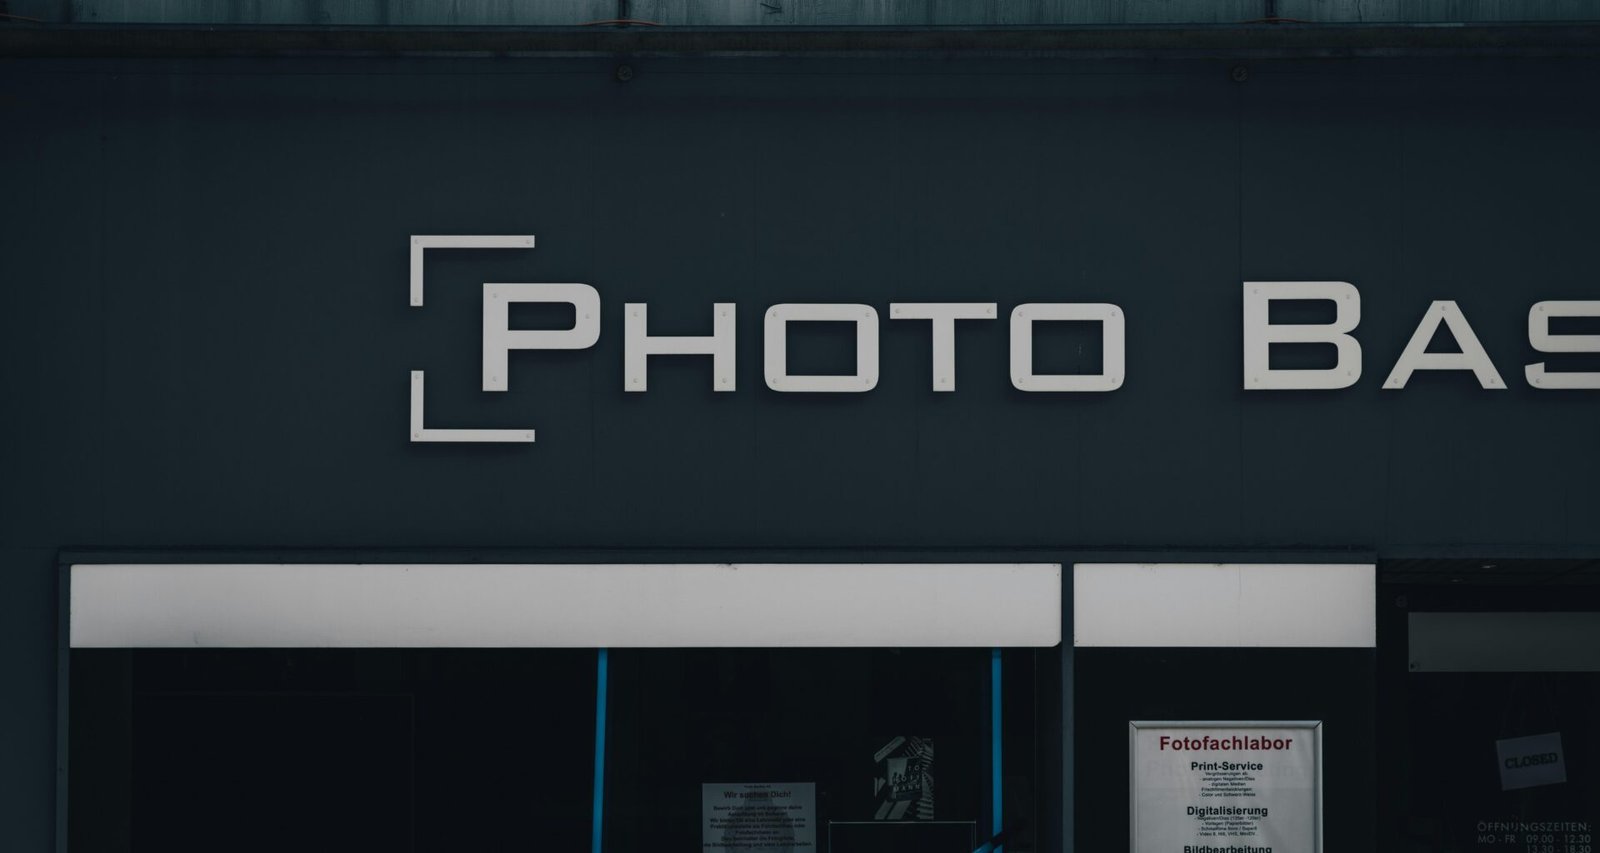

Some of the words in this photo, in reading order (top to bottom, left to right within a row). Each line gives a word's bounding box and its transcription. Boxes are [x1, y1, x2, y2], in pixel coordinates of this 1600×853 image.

[482, 283, 1125, 393] PHOTO
[1243, 281, 1600, 390] BAS
[1159, 735, 1293, 751] Fotofachlabor
[1191, 761, 1264, 771] Print-Service
[1504, 752, 1558, 769] CLOSED
[723, 791, 738, 799] Wir
[771, 790, 792, 799] Dich!
[1187, 806, 1268, 817] Digitalisierung
[1477, 819, 1592, 832] ÖFFNUNGSZEITEN:
[1477, 834, 1496, 844] MO
[1505, 834, 1517, 844] FR
[1526, 834, 1554, 844] 09.00
[1564, 834, 1592, 844] 12.30
[1527, 845, 1554, 853] 13.30
[1564, 845, 1592, 853] 18.30
